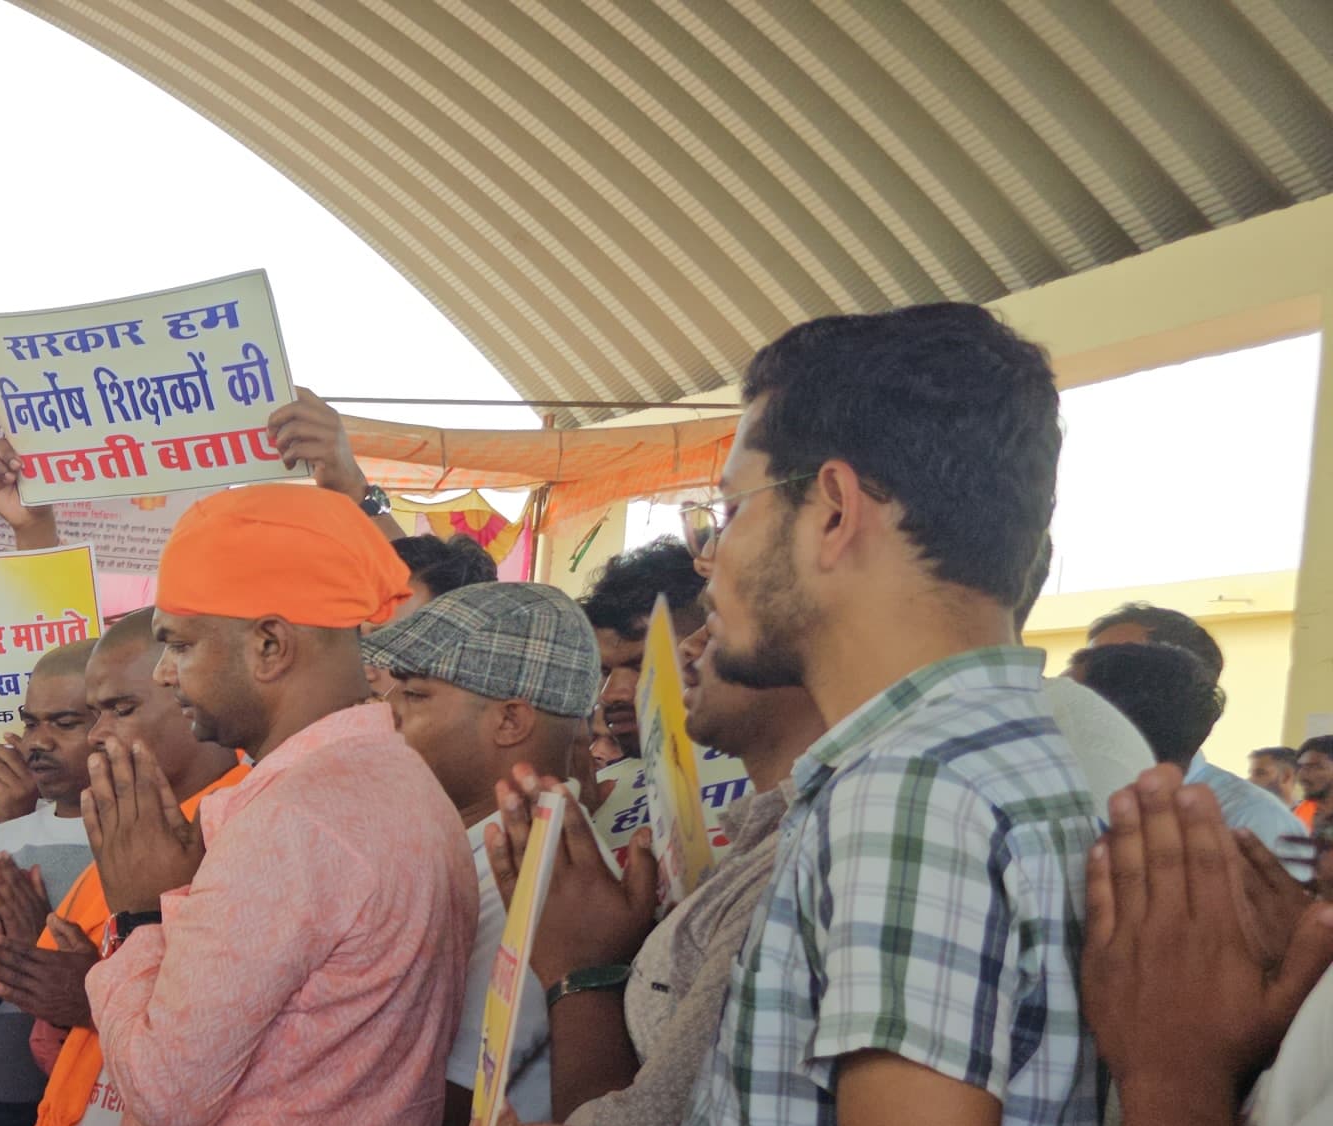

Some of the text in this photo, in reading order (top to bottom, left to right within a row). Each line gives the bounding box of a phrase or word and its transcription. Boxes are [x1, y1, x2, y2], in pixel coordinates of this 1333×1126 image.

[3, 300, 240, 361] सरकार हम
[94, 351, 216, 427] शिक्षकों
[221, 341, 276, 407] की
[19, 433, 148, 485] गलती
